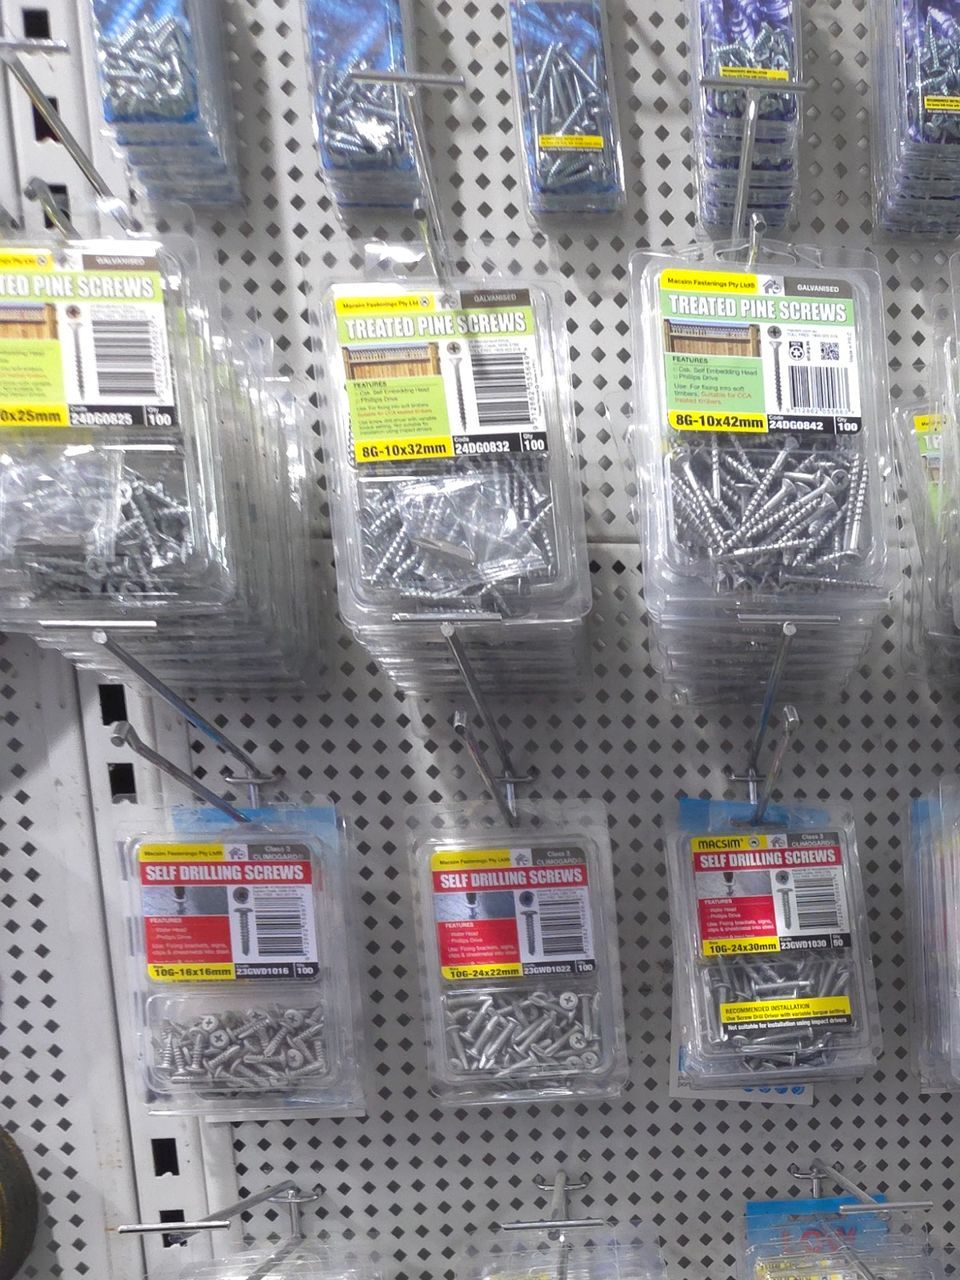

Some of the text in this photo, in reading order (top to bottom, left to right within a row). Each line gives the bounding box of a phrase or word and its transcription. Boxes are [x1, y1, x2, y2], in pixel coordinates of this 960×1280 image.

[32, 275, 73, 296] PINE
[78, 276, 154, 297] SCREWS
[694, 279, 727, 288] Fastenings
[729, 281, 738, 289] Pty
[668, 295, 846, 322] TREATED PINE SCREWS
[345, 312, 526, 340] TREATED PINE SCREWS
[148, 413, 171, 425] 100
[676, 415, 763, 428] 8G-10x42mm
[838, 423, 858, 431] 100
[362, 443, 446, 457] 8G-10x32mm
[524, 440, 544, 450] 100
[698, 840, 740, 849] MACSIM
[700, 849, 835, 868] SELF DRILLING SCREWS
[146, 865, 304, 880] SELF DRILLING SCREWS
[440, 868, 582, 888] SELF DRILLING SCREWS
[710, 943, 776, 953] 10G-24x30mm
[726, 1003, 810, 1014] RECOMMENDED INSTALLATION
